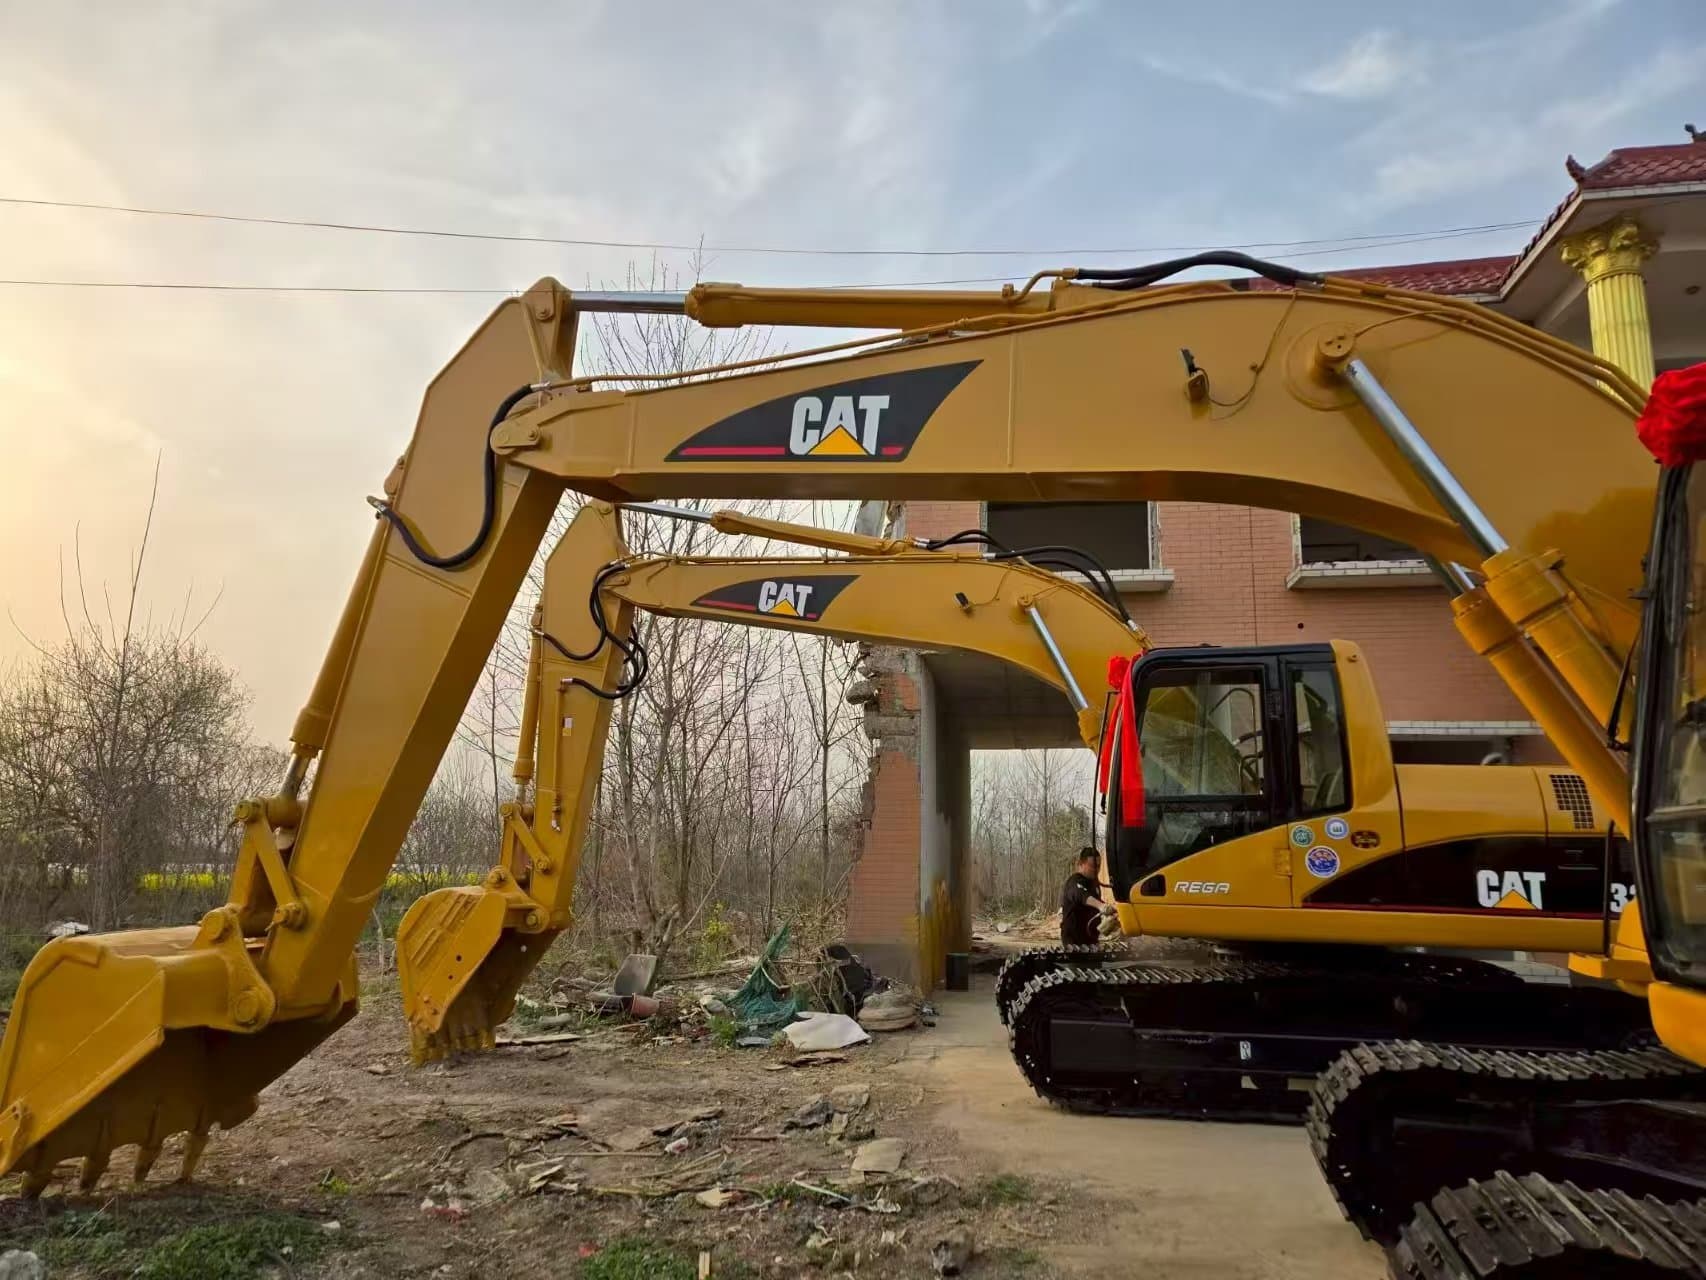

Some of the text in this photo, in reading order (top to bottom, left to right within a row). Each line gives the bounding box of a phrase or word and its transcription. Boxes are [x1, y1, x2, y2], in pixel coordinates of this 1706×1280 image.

[790, 395, 890, 456] CAT
[758, 581, 813, 617] CAT
[1174, 881, 1230, 894] REGA
[1476, 869, 1546, 910] CAT
